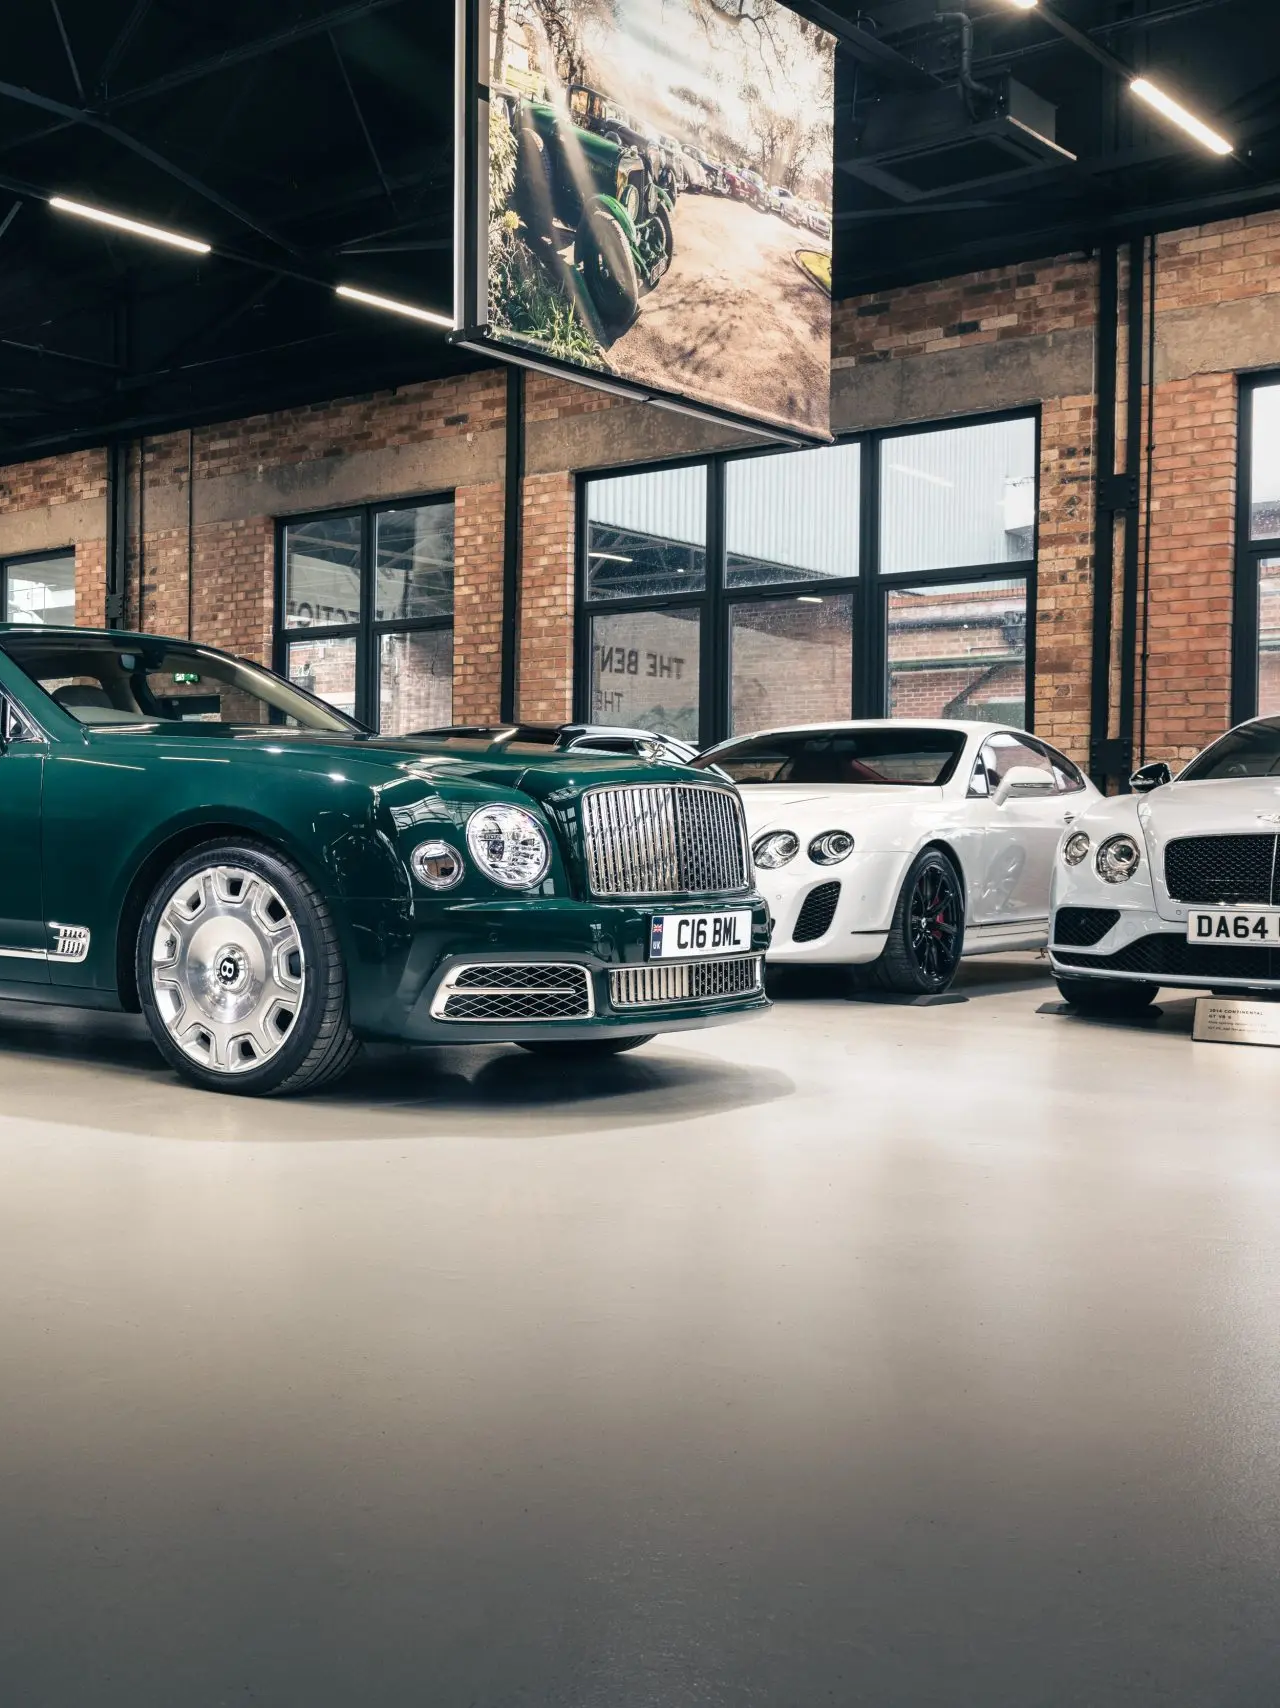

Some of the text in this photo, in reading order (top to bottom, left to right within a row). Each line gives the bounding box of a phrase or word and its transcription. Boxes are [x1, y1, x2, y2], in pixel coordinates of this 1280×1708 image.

[677, 917, 741, 949] C16 BML
[1197, 915, 1269, 939] DA64
[652, 941, 661, 950] UK
